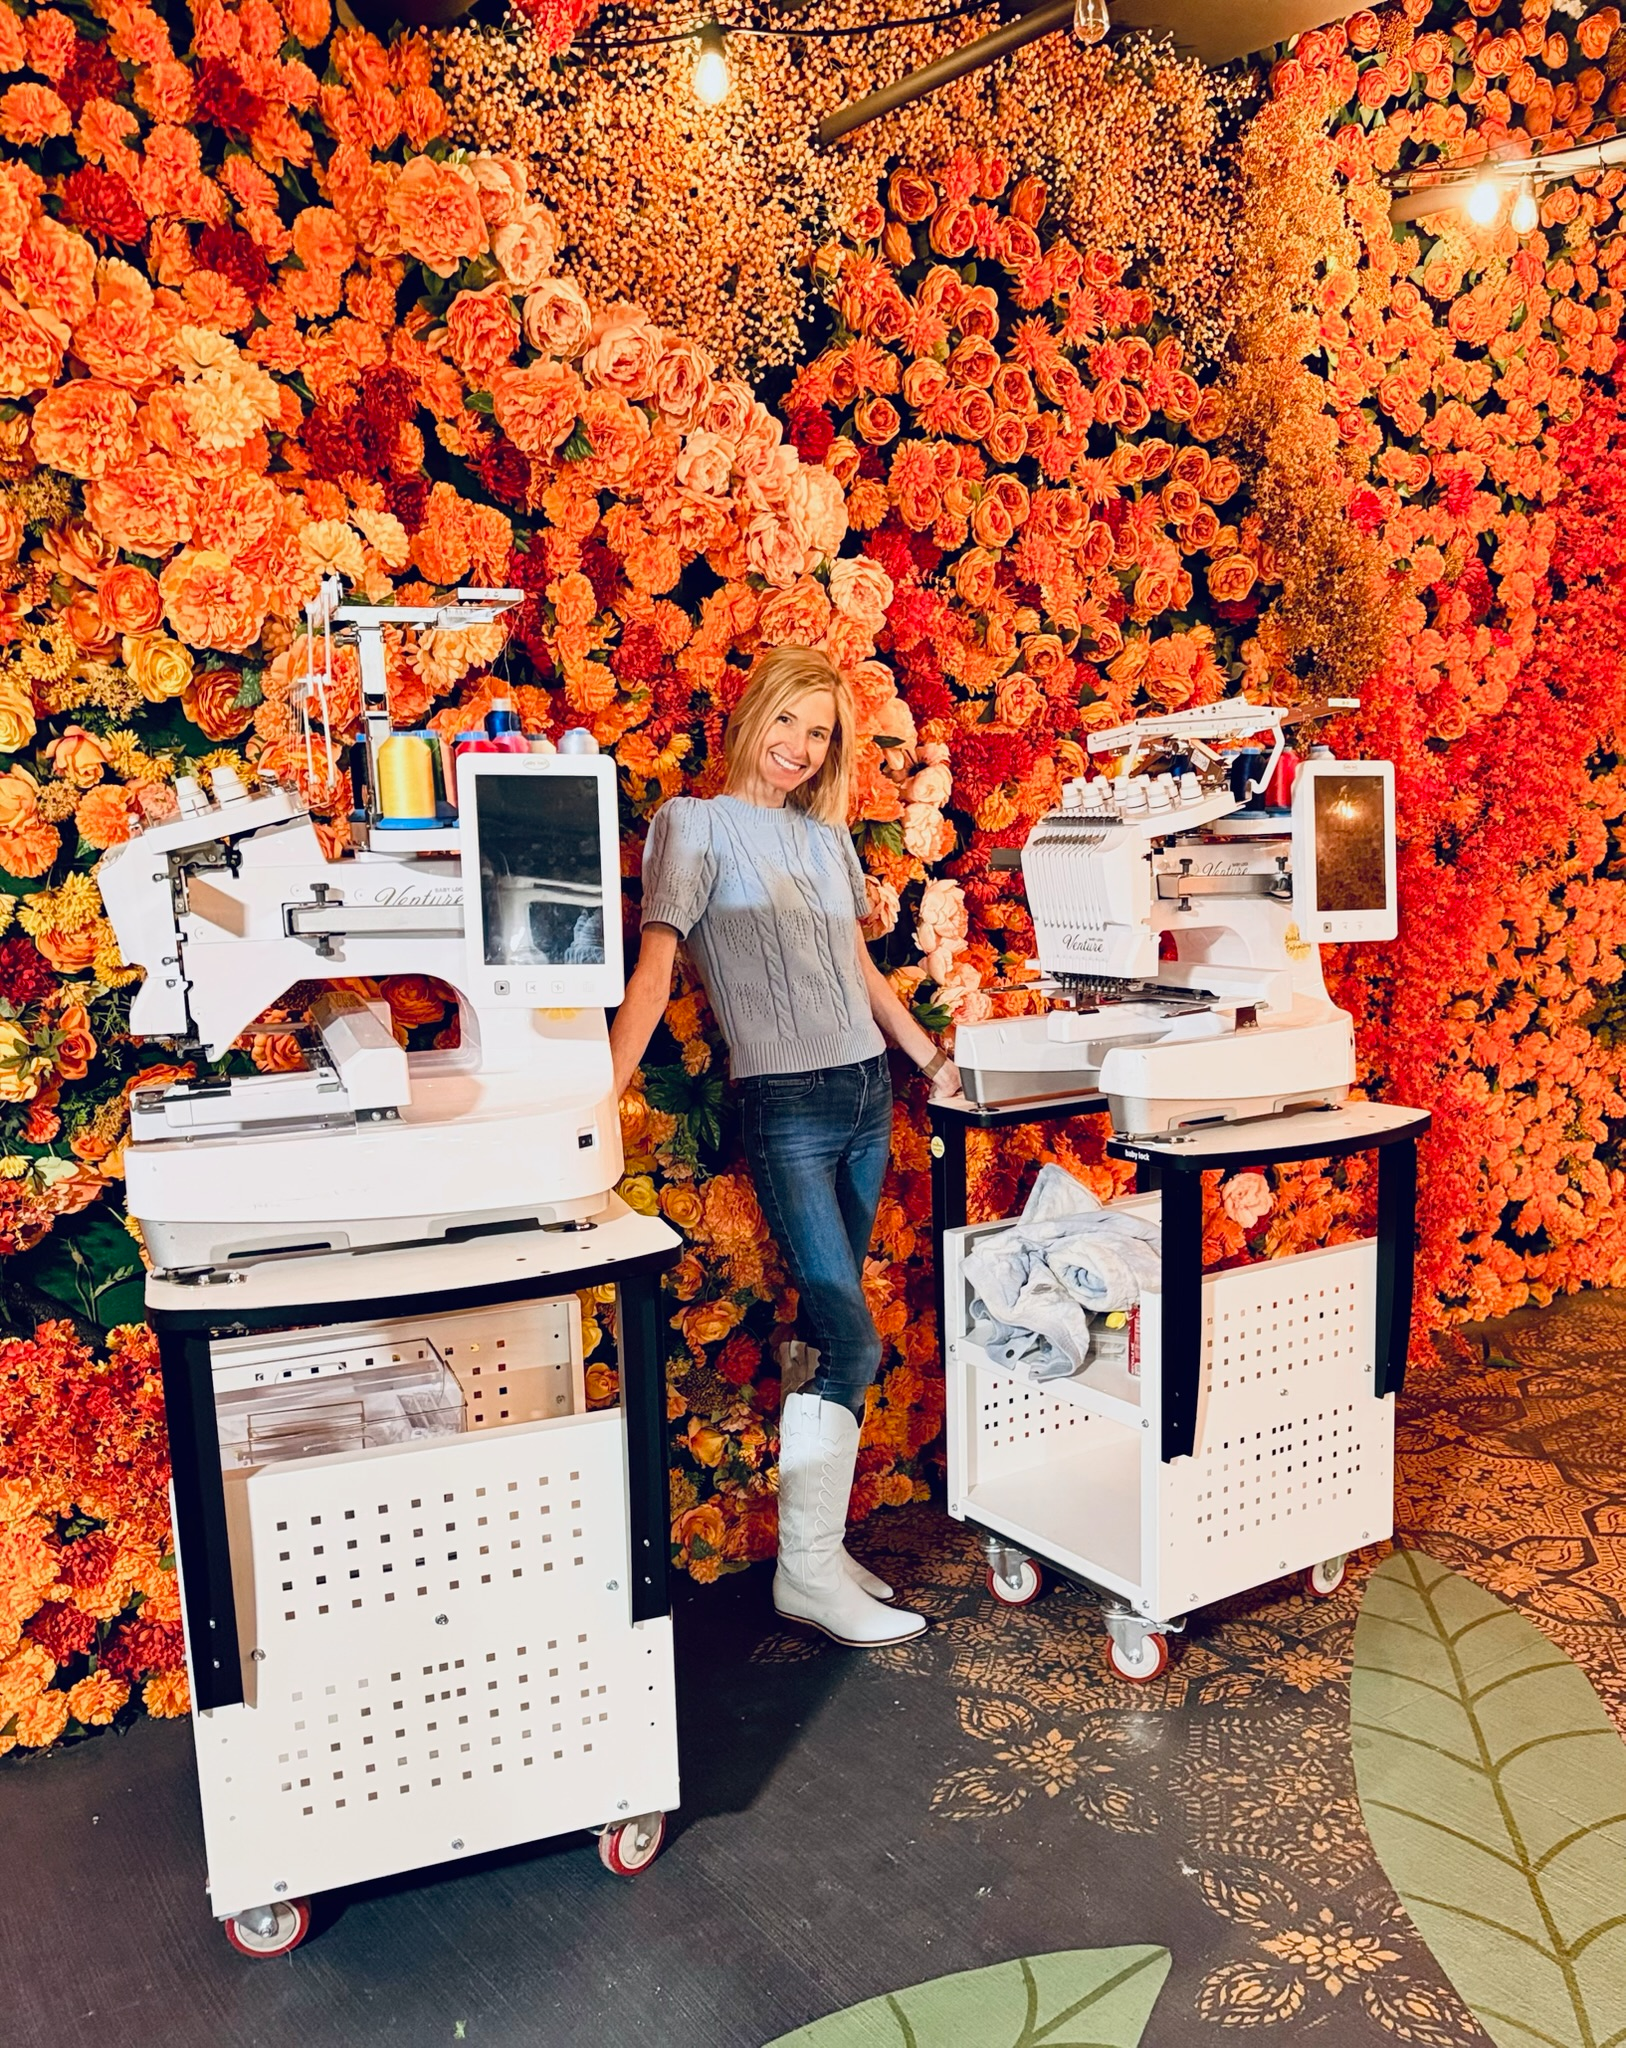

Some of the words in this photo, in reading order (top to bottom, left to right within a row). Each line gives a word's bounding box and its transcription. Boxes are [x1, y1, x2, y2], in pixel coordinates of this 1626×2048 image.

[374, 885, 464, 906] Venture
[1062, 933, 1104, 953] Venture
[1125, 1149, 1138, 1160] baby
[1138, 1151, 1150, 1161] lock
